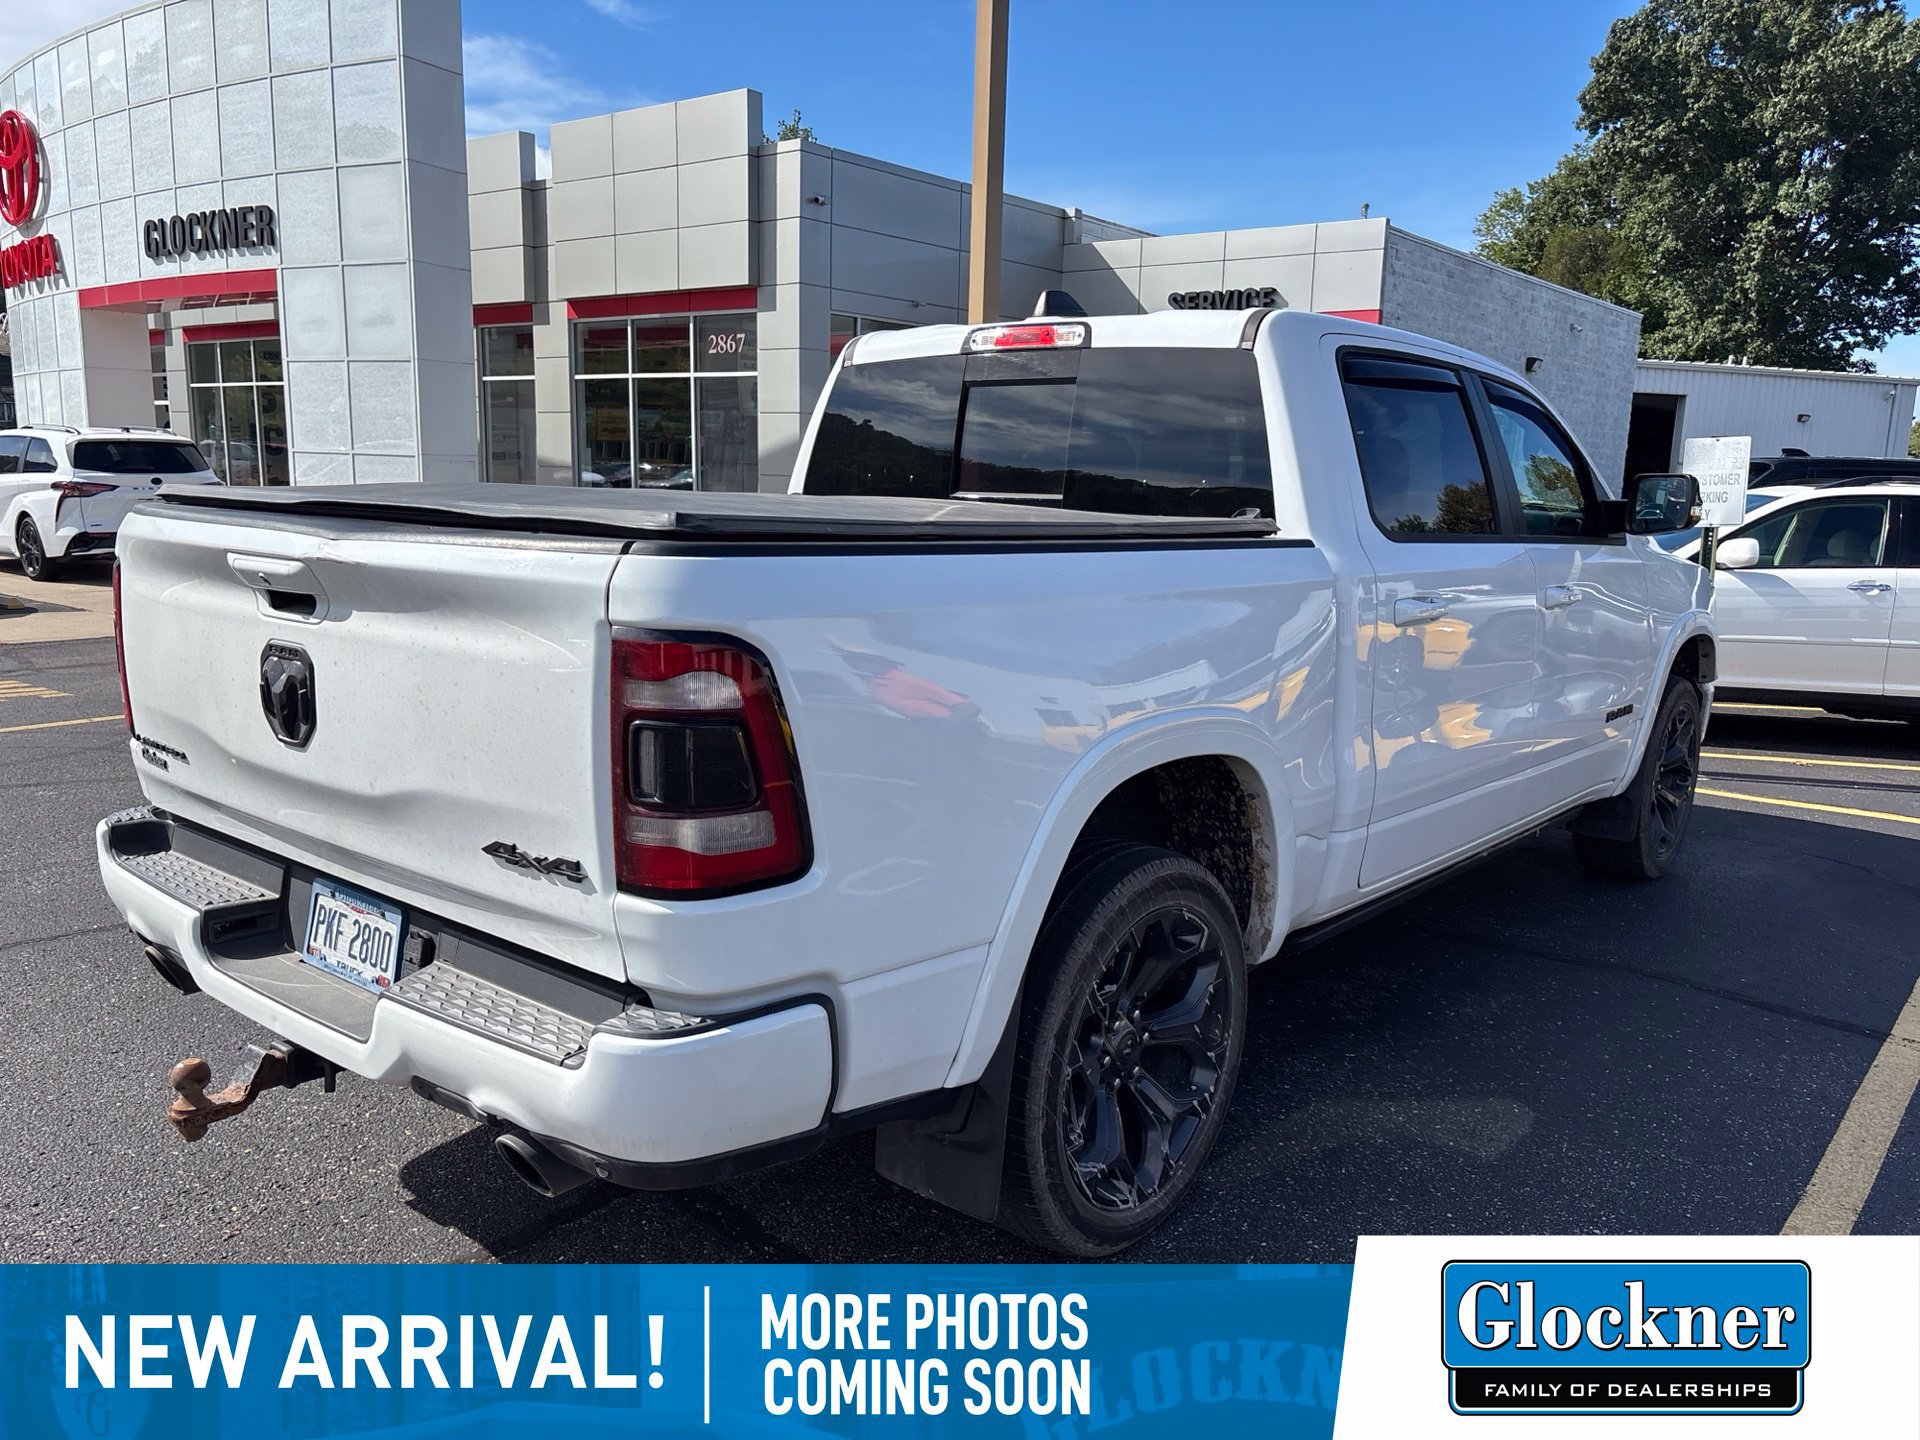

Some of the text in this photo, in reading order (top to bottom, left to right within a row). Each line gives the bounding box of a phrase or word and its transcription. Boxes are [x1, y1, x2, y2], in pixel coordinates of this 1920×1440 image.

[143, 205, 277, 259] GLOCKNER
[1167, 287, 1278, 310] SERVICE
[708, 333, 746, 354] 2867
[313, 903, 393, 974] PKF 2800
